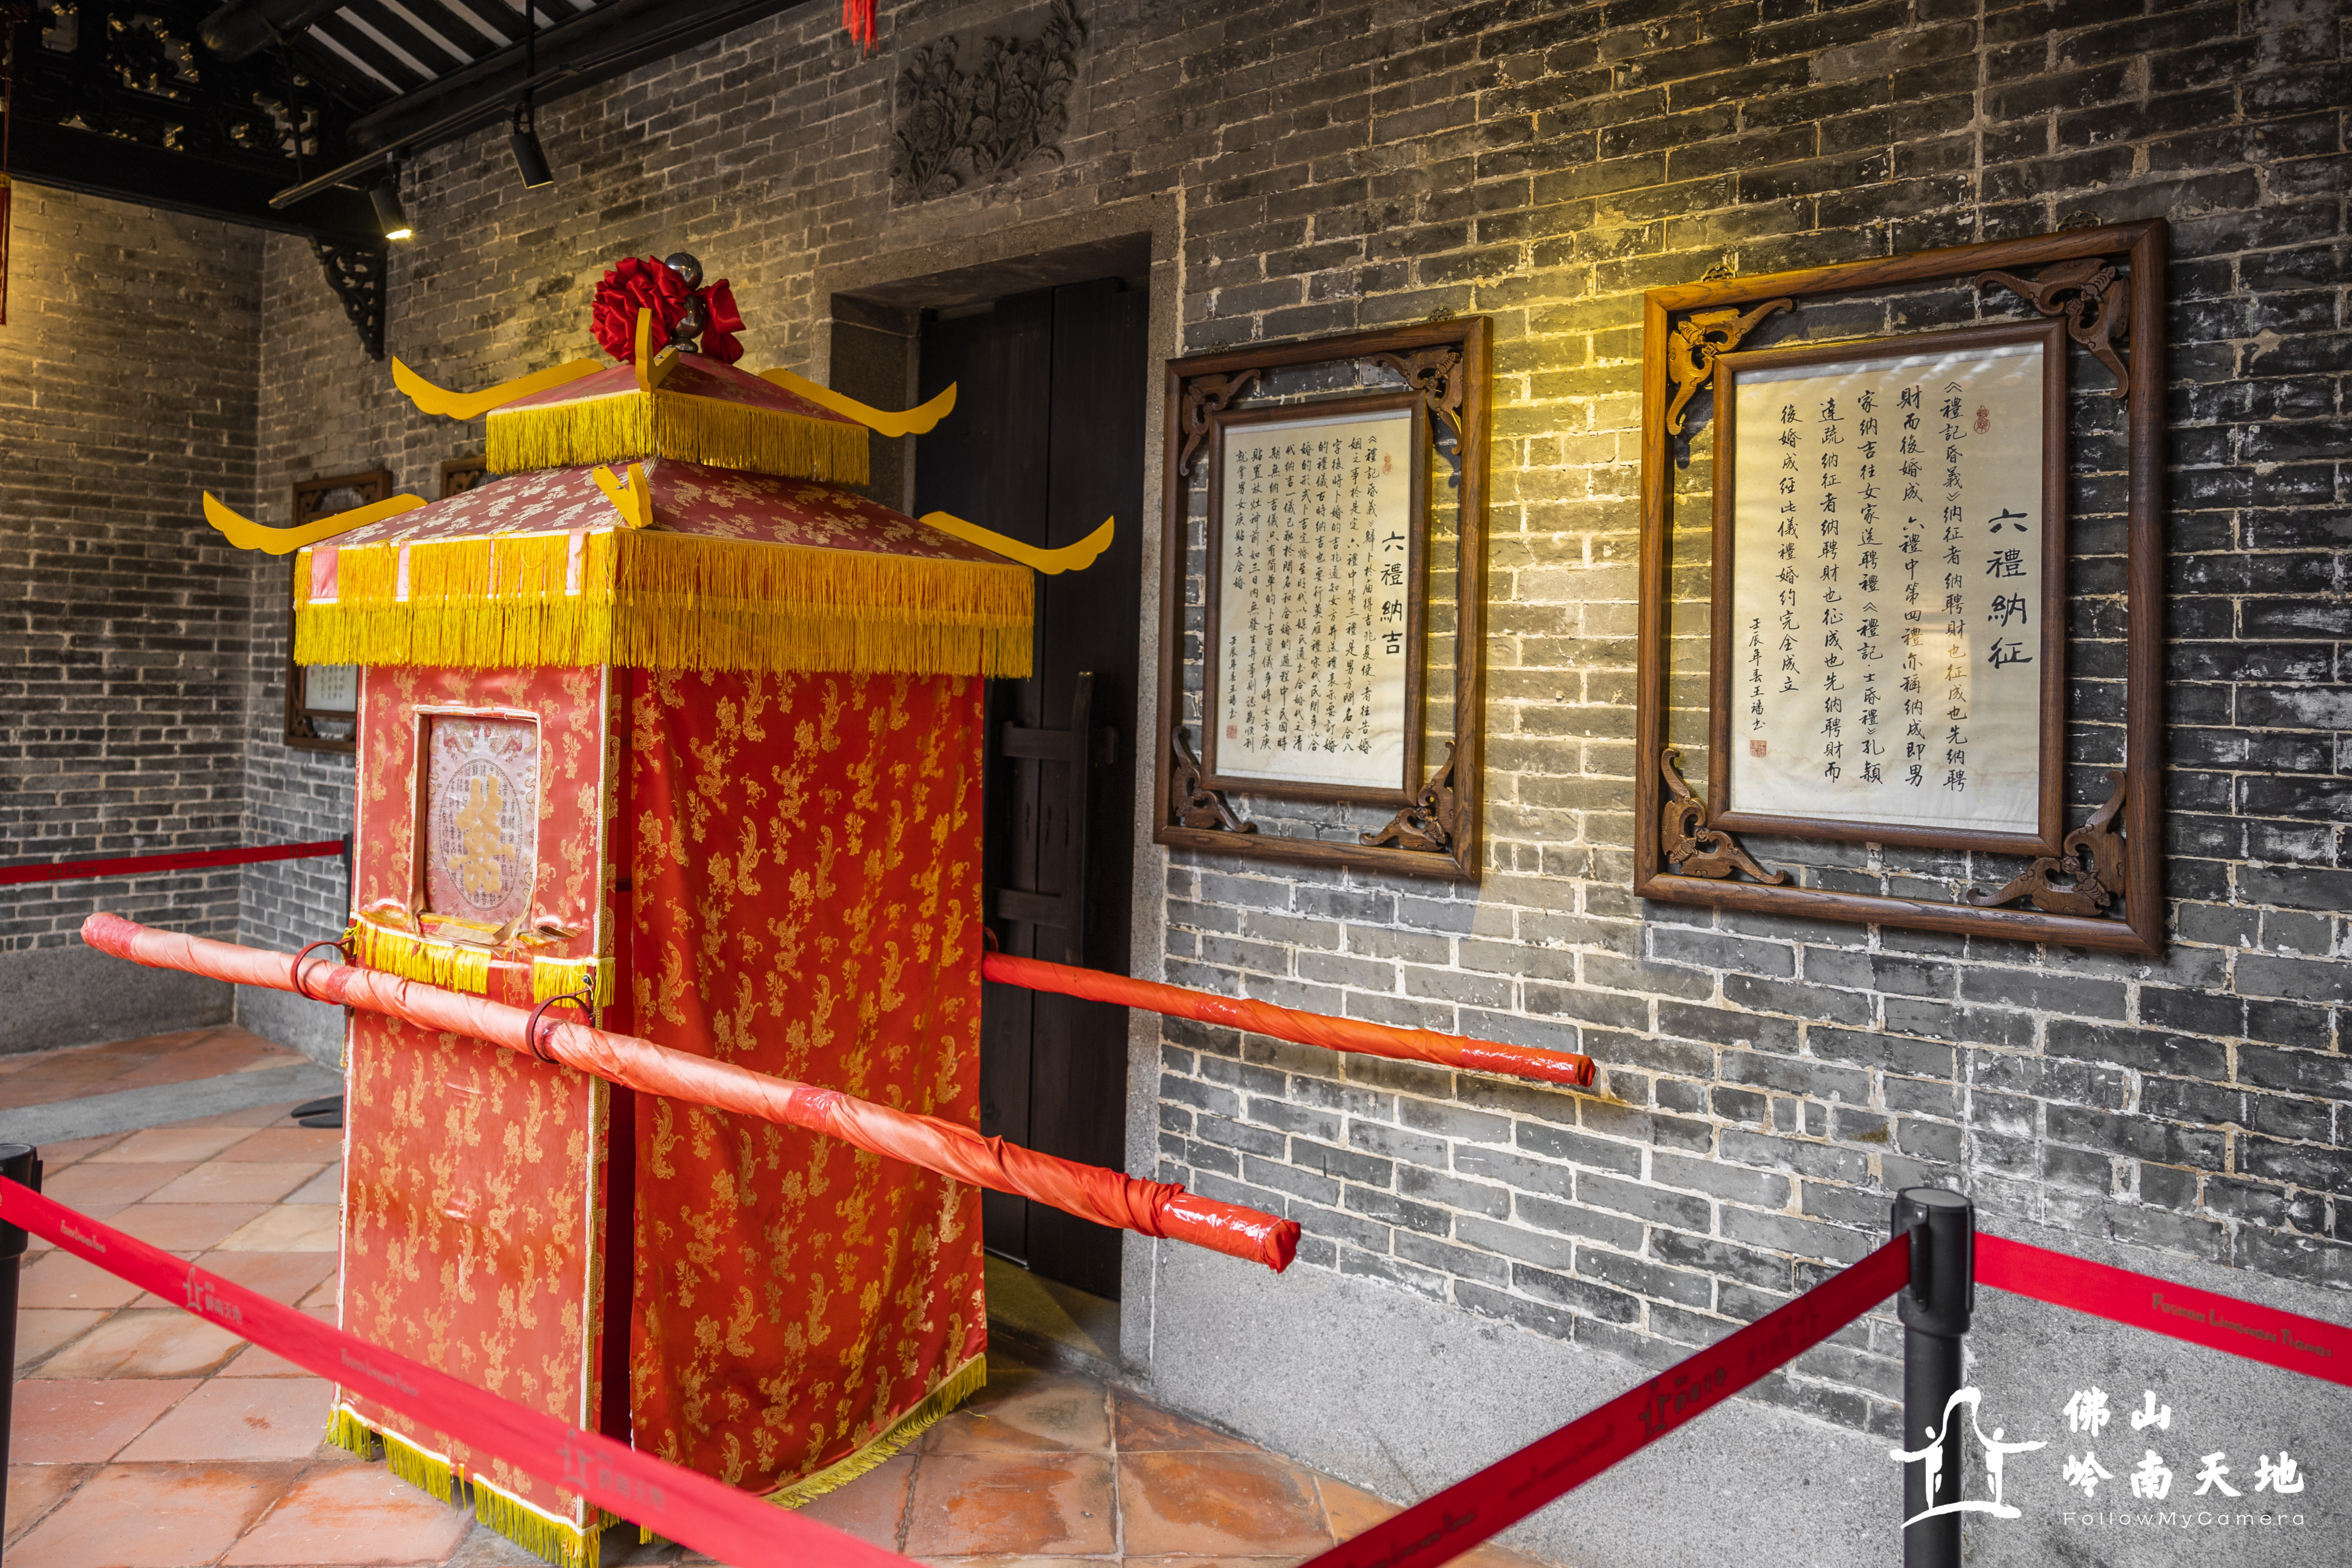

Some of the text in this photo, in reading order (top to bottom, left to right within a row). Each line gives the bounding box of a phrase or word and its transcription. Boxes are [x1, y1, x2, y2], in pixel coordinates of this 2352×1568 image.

[1380, 530, 1405, 655] 六禮納吉
[1985, 508, 2033, 670] 六禮納征
